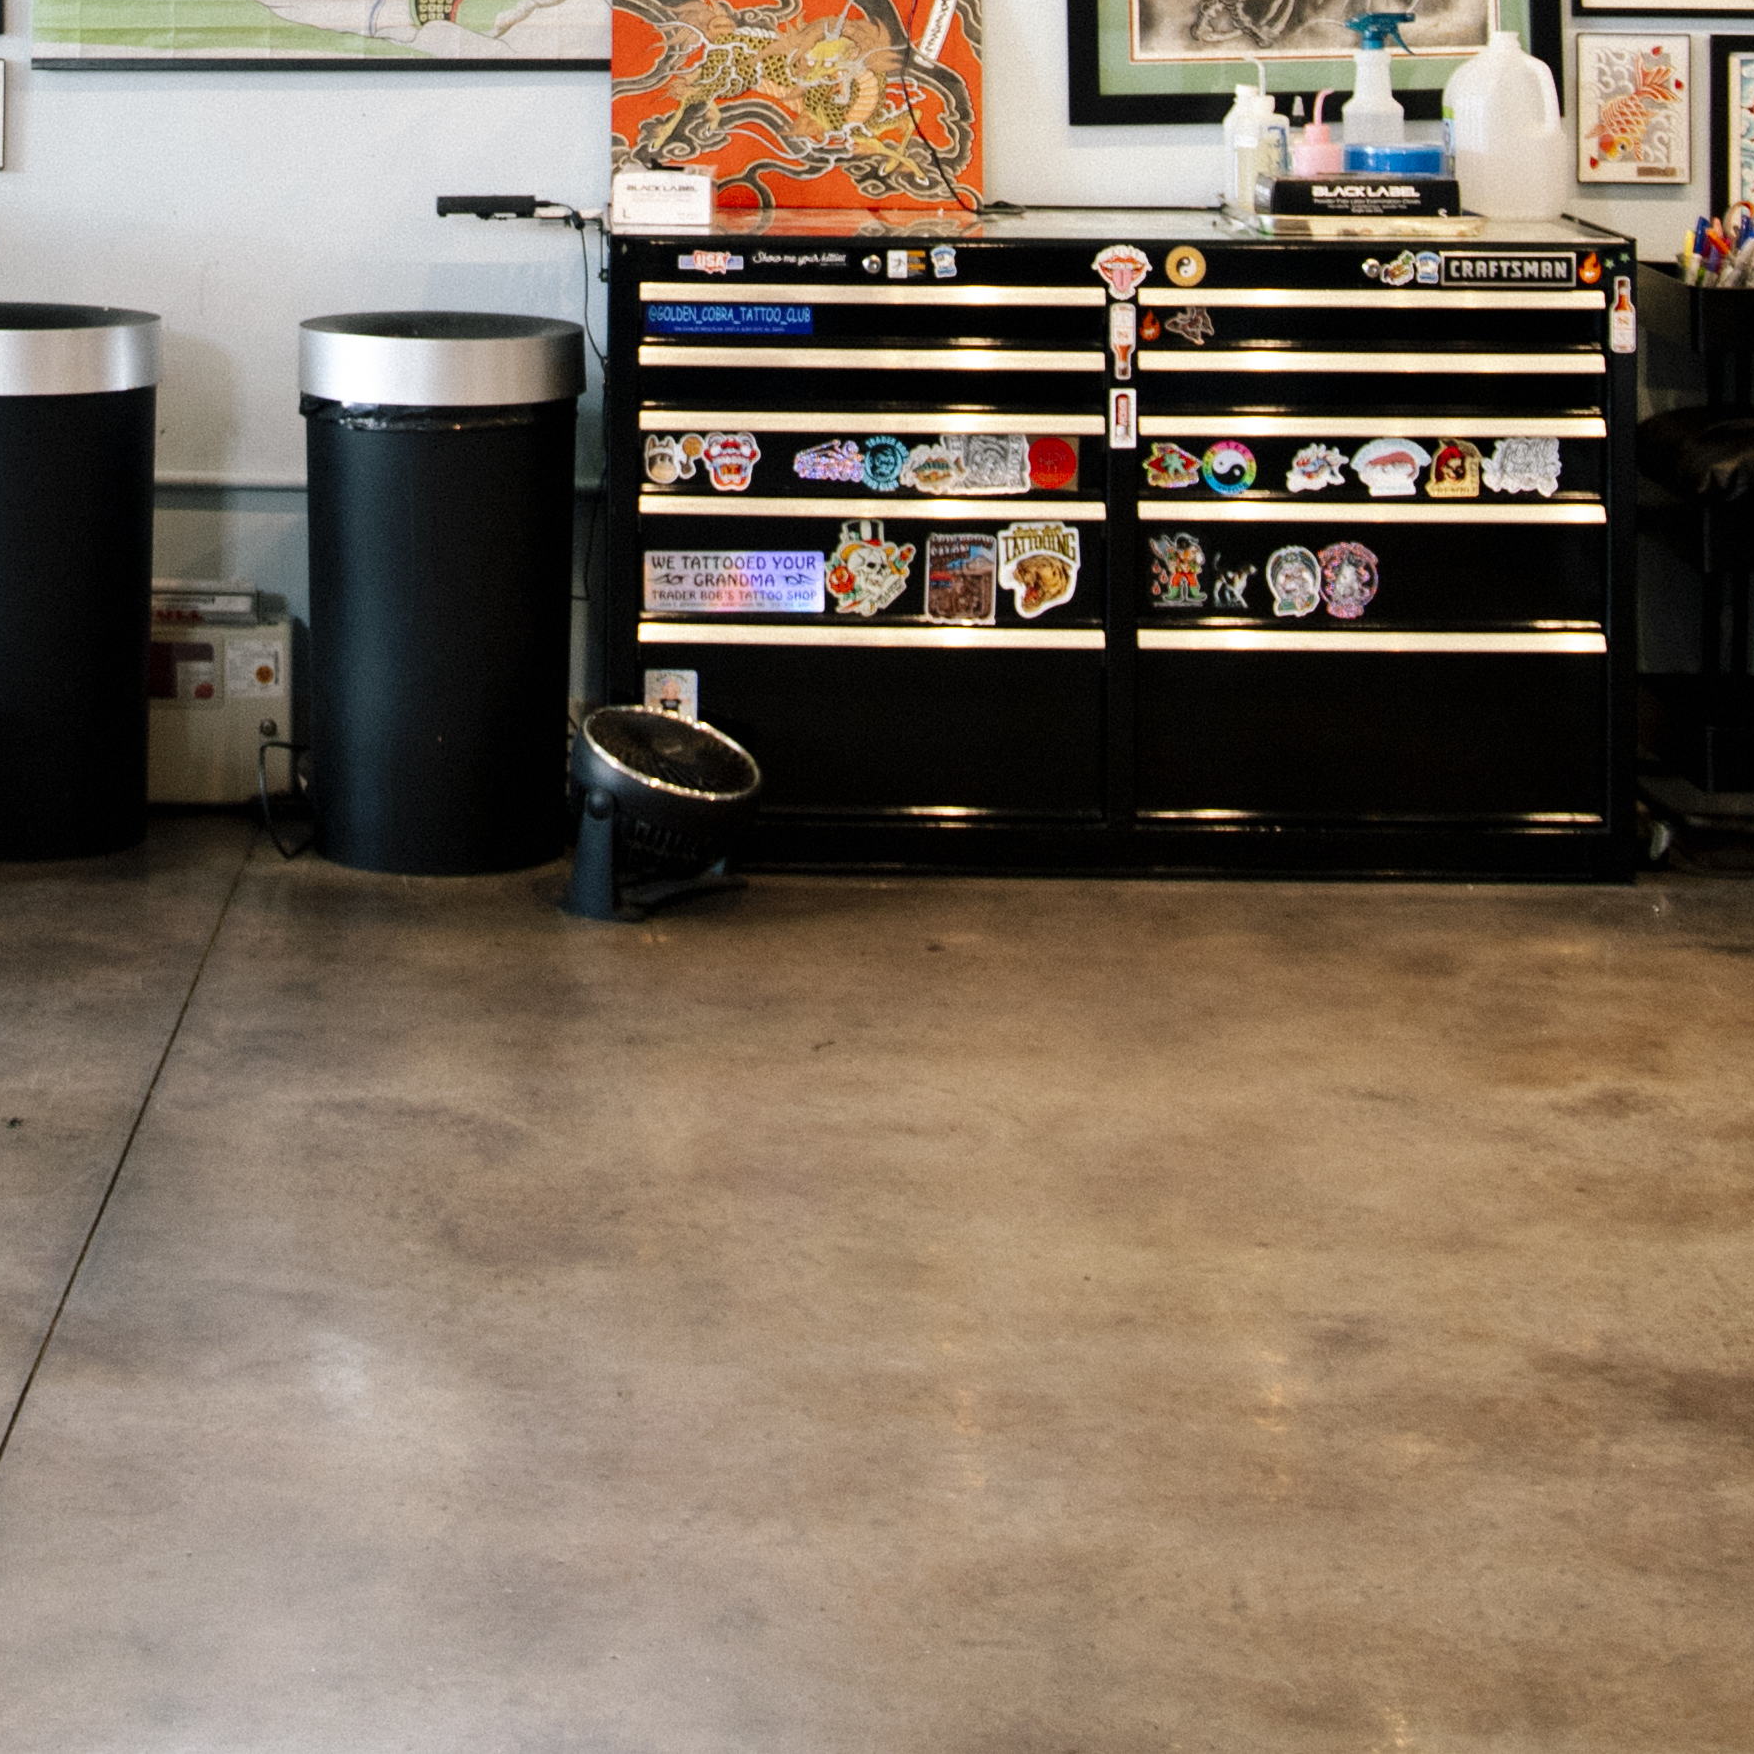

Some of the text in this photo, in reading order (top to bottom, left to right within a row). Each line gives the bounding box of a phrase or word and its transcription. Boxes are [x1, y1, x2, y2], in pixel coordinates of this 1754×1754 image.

[1311, 185, 1421, 198] BLACK LABEL
[695, 253, 727, 269] USA
[1449, 258, 1568, 279] CRAFTSMAN
[648, 305, 812, 326] @GOLDEN_COBRA_TATTOO_CLUB
[651, 556, 817, 570] WE TATTOOED YOUR
[693, 573, 777, 588] GRANDMA
[652, 590, 697, 601] TRADER
[738, 590, 784, 601] TATTOO
[787, 590, 818, 601] SHOP
